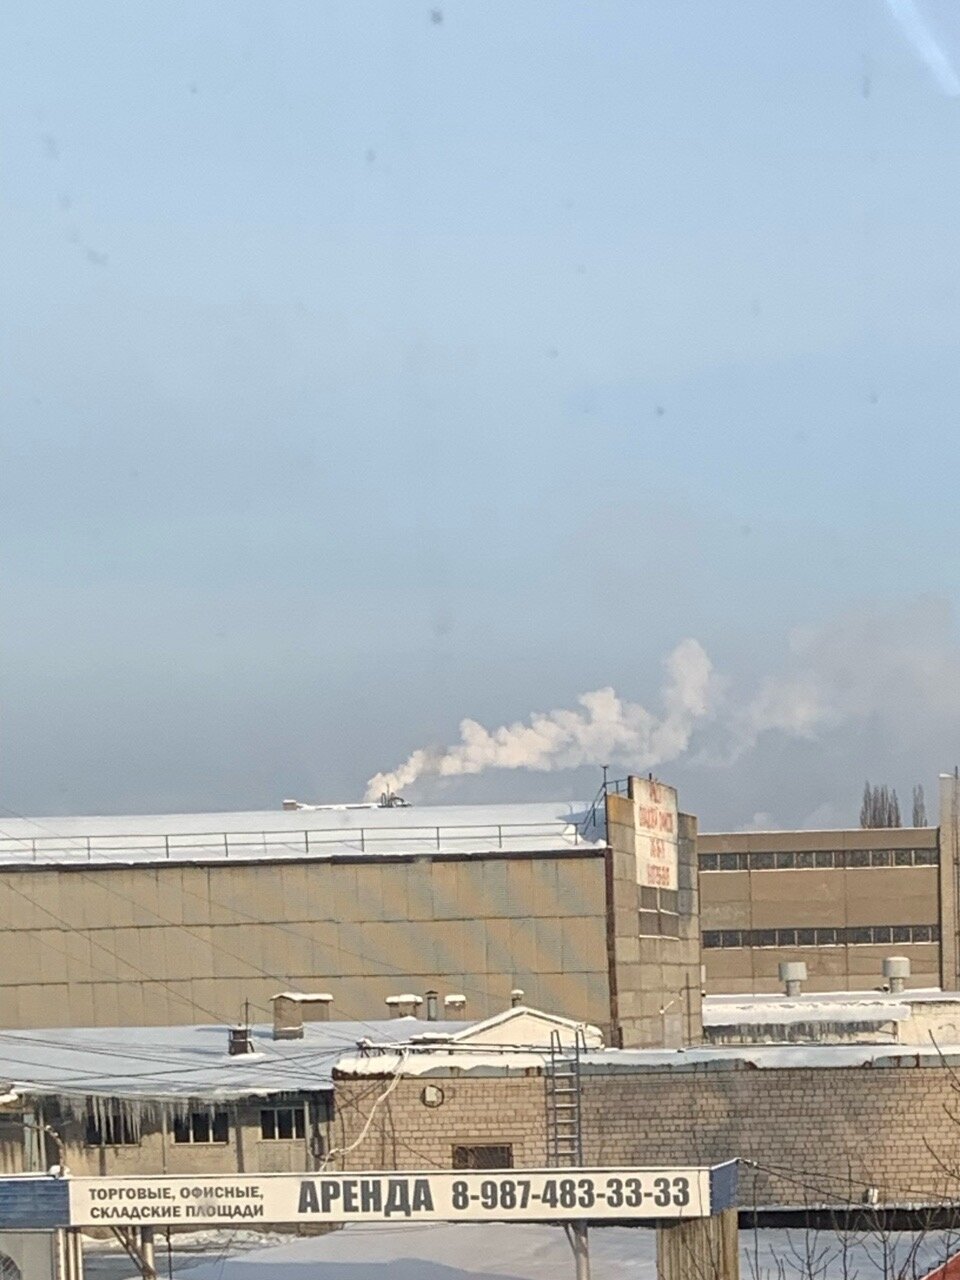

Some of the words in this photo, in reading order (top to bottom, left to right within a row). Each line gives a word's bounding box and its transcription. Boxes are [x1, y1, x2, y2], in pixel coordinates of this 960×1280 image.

[89, 1187, 176, 1201] ТОРГОВЫЕ,
[180, 1186, 264, 1200] ОФИСНЫЕ,
[297, 1179, 434, 1217] АРЕНДА
[452, 1177, 690, 1210] 8-987-483-33-33
[90, 1206, 181, 1220] СКЛАДСКИЕ
[186, 1205, 264, 1219] ПЛОЩАДИ
